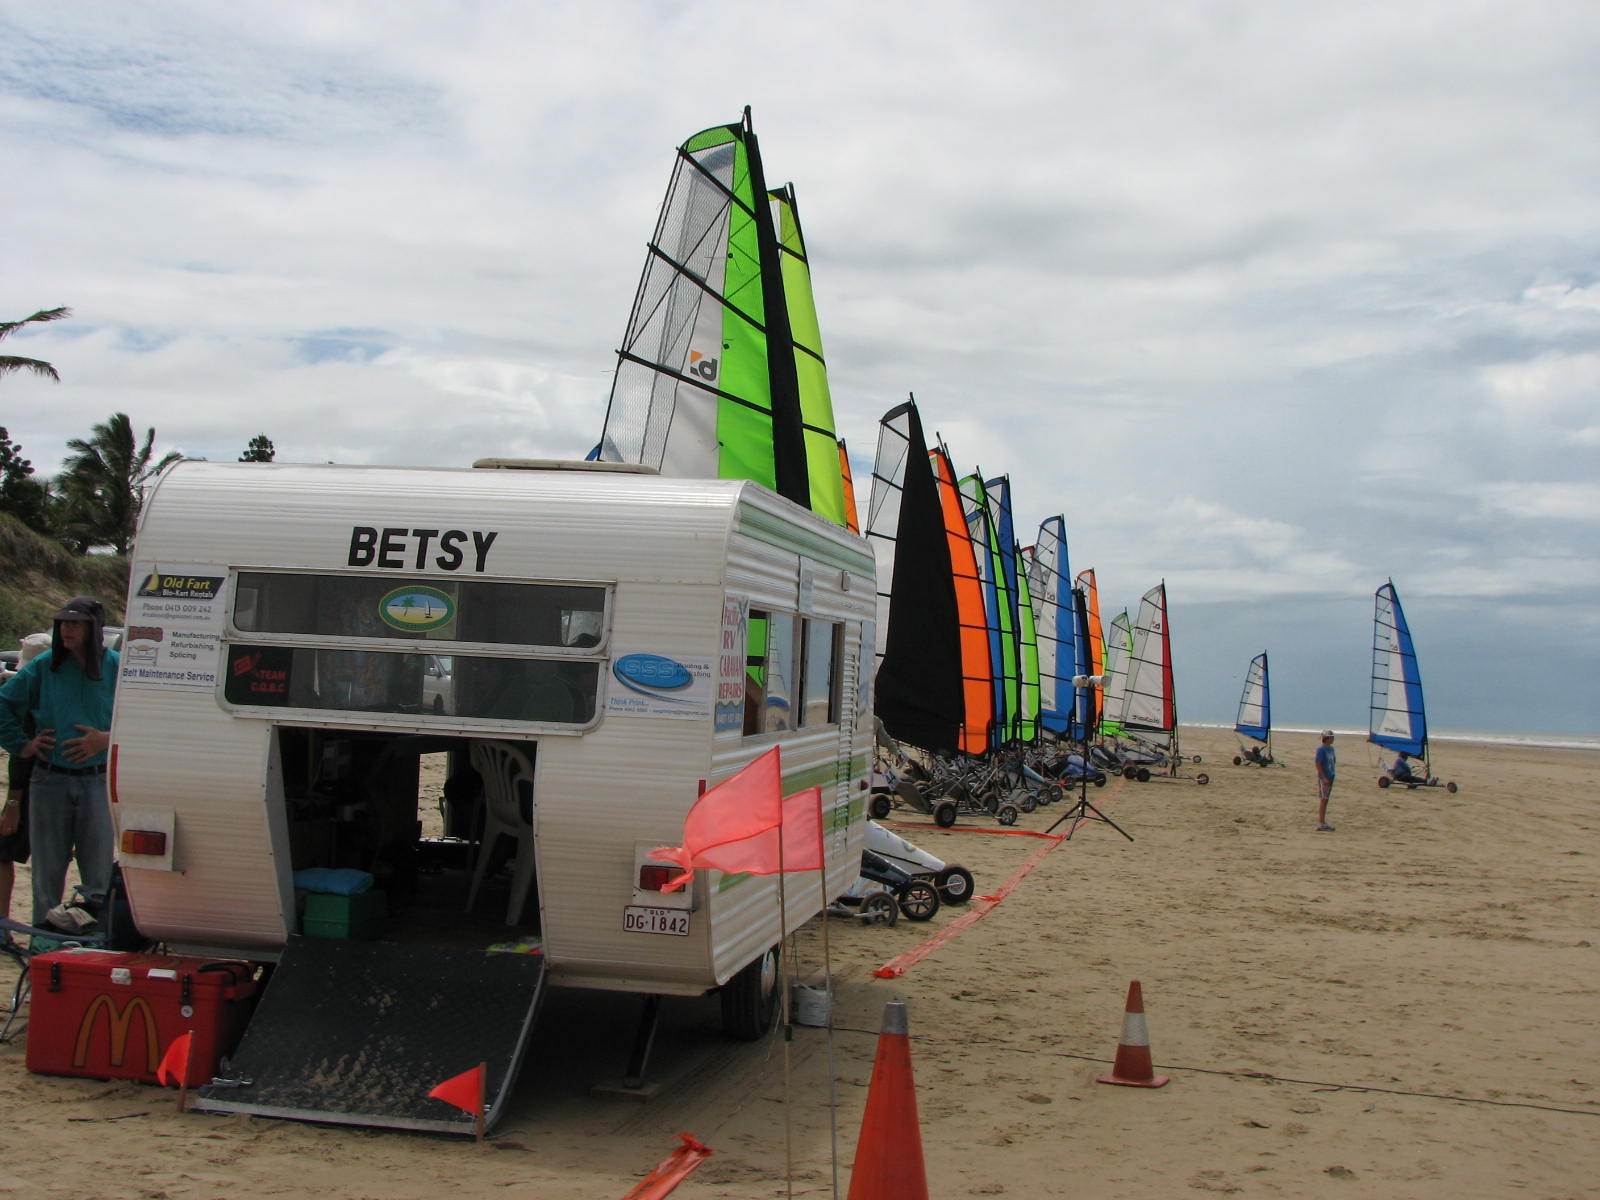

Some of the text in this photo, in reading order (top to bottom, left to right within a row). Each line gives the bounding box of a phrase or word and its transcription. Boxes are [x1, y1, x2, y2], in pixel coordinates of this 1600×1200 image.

[348, 526, 498, 573] BETSY
[163, 576, 211, 591] Old Fart
[189, 590, 214, 599] Rentals
[723, 630, 737, 650] RV
[169, 651, 197, 660] Splicing
[122, 667, 215, 682] Belt Maintenance Service
[718, 682, 743, 700] REPAIRS
